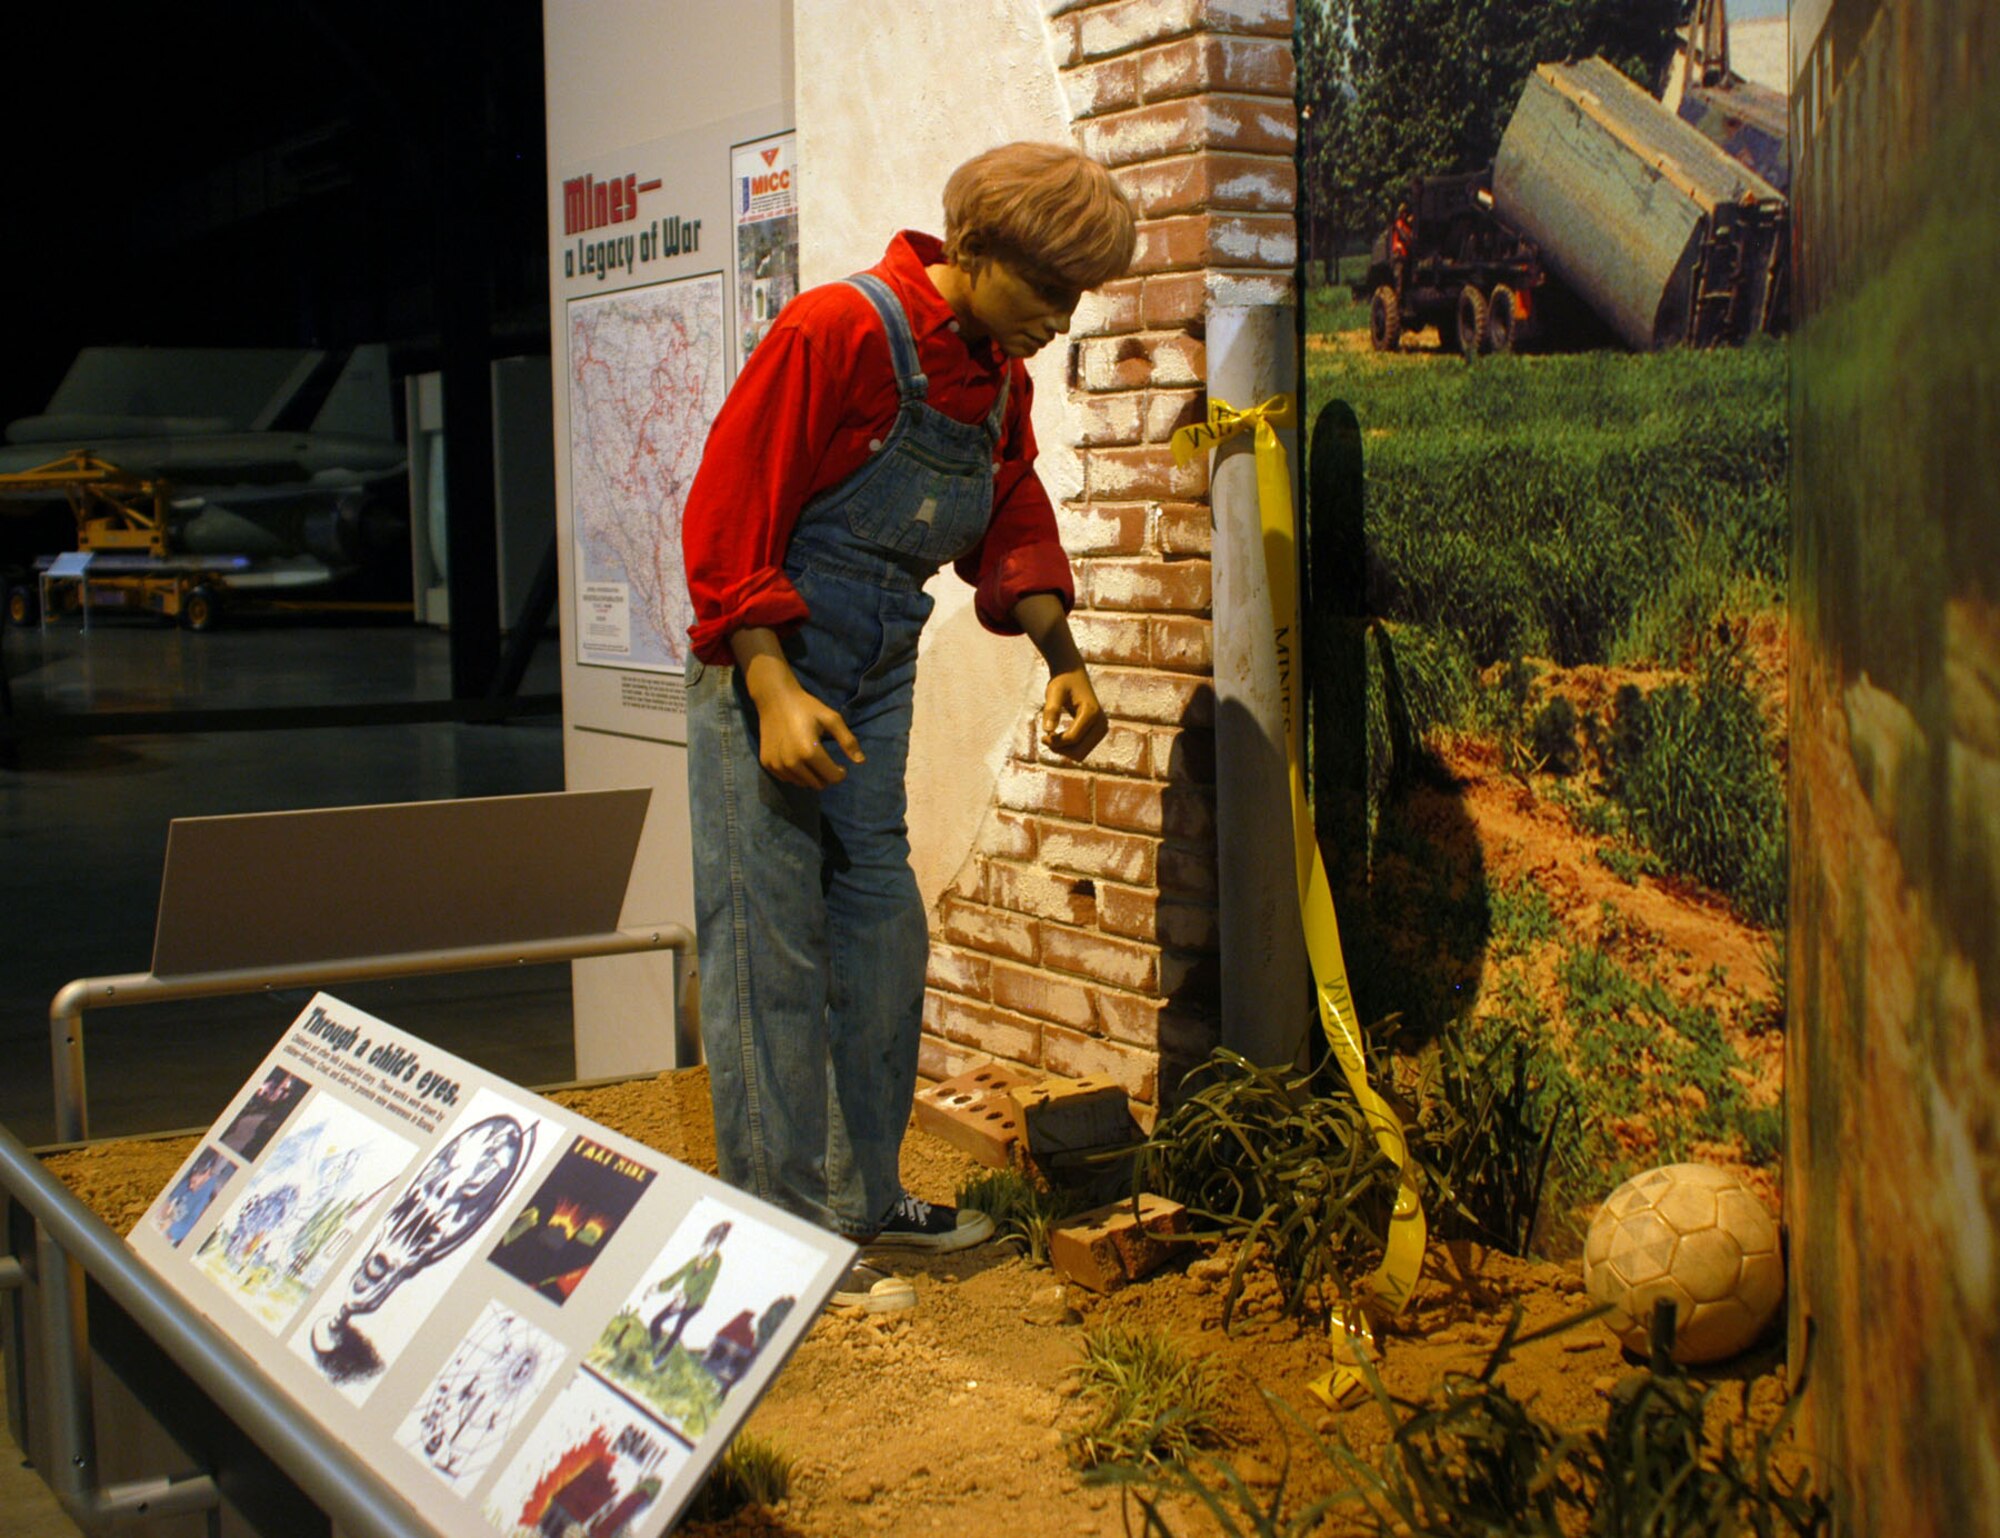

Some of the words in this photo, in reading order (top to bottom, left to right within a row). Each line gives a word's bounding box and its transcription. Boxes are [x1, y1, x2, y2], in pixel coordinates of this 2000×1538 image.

[564, 249, 573, 279] a
[639, 221, 657, 262] of
[662, 214, 701, 257] War
[303, 1006, 360, 1052] Through
[353, 1038, 372, 1058] a
[367, 1042, 420, 1084] child's
[416, 1070, 459, 1108] eyes.
